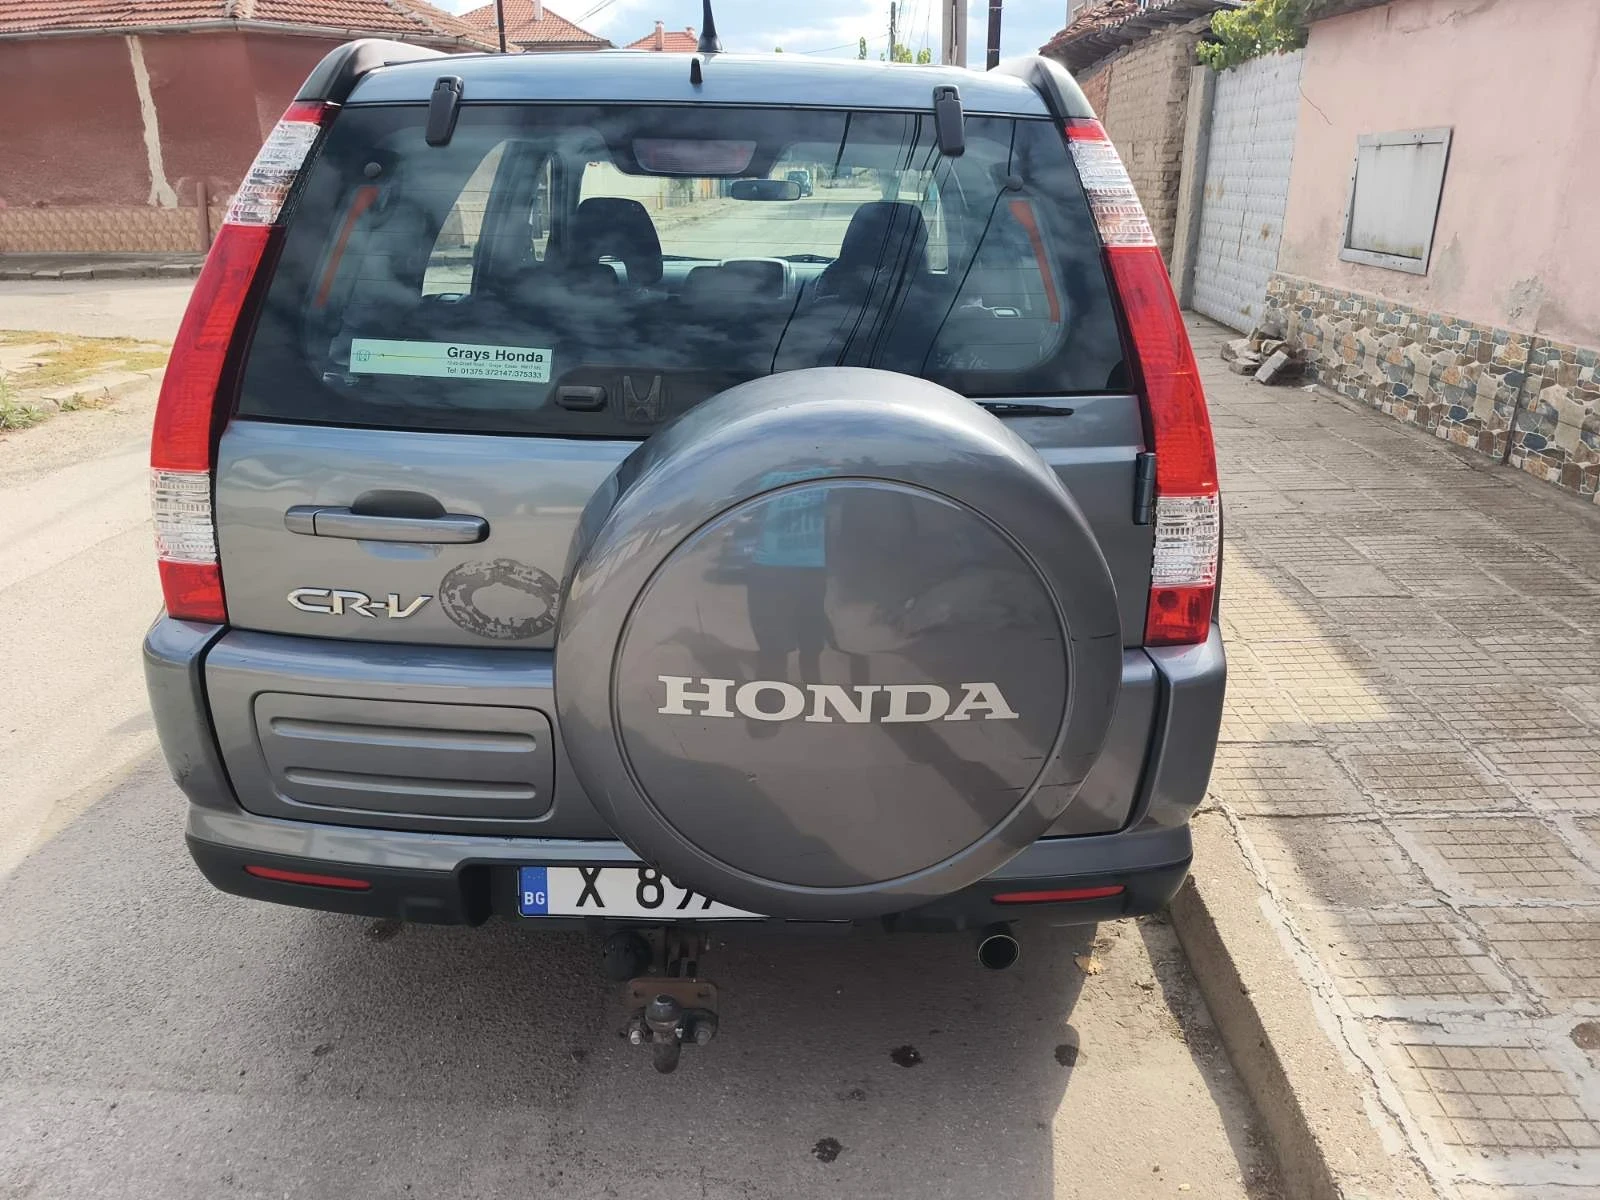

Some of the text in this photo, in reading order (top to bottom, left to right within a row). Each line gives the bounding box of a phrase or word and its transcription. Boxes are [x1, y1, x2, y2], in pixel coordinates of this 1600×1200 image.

[447, 346, 544, 363] Grays Honda
[287, 587, 434, 618] CR-V
[657, 674, 1020, 723] HONDA
[524, 891, 545, 905] BG
[576, 866, 606, 907] X
